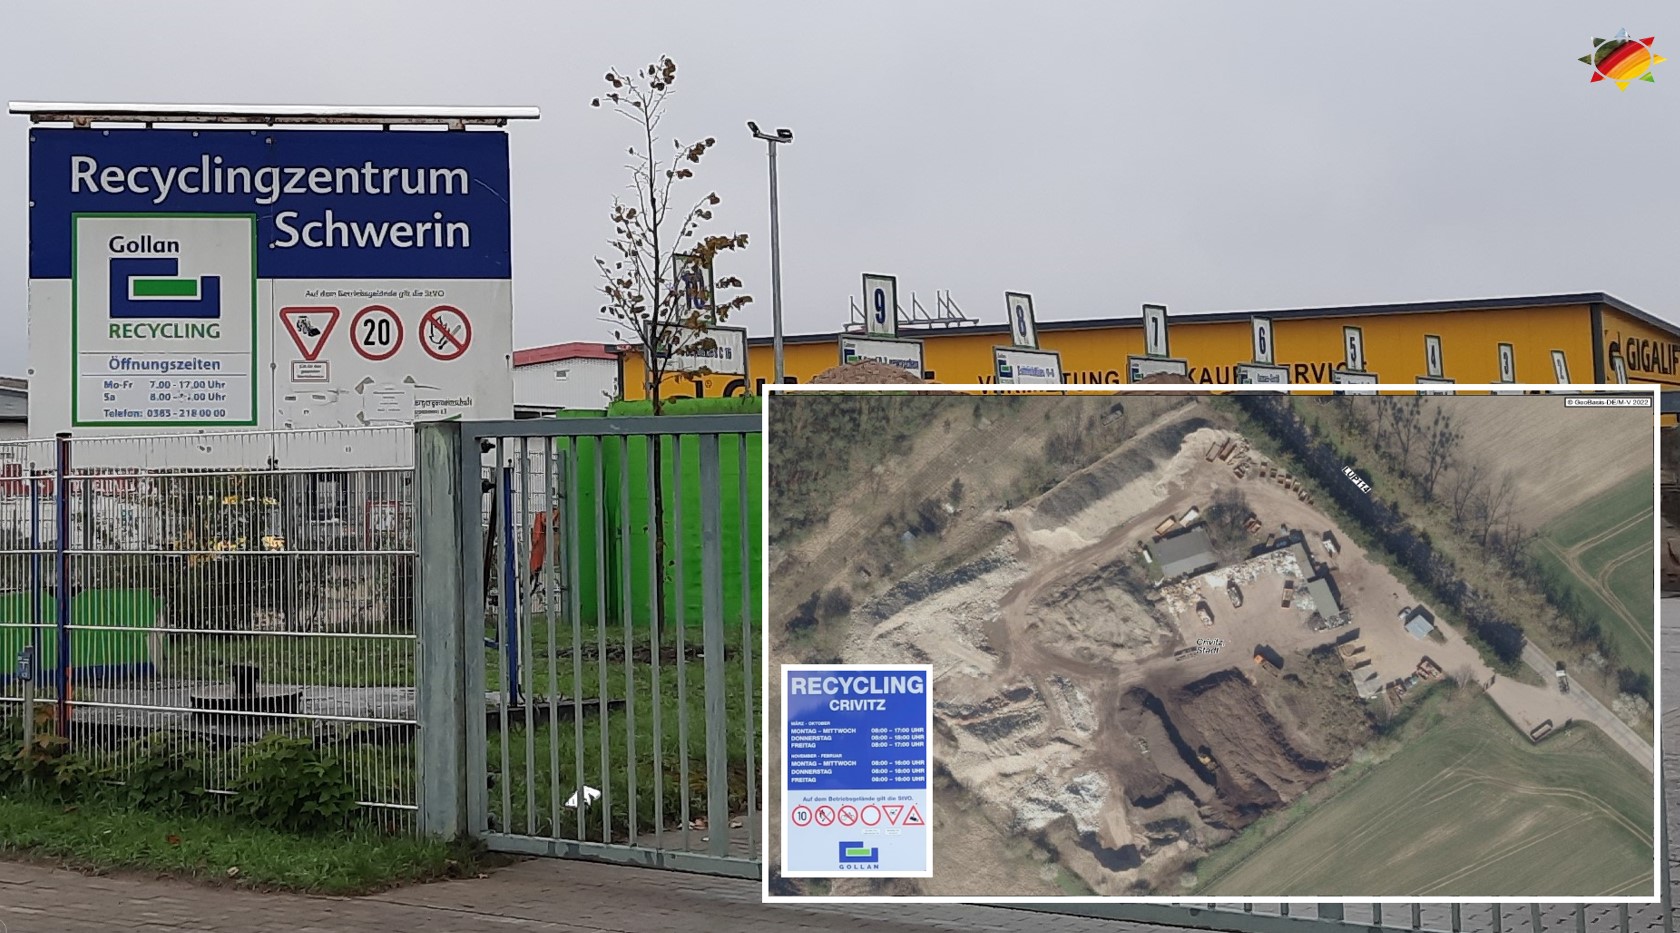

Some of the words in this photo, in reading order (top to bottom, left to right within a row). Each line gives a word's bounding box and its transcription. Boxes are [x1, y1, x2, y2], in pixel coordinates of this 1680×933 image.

[70, 154, 470, 205] Recyclingzentrum
[274, 210, 470, 249] Schwerin
[109, 234, 180, 255] Gollan
[873, 288, 886, 325] 9
[109, 323, 220, 339] RECYCLING
[363, 318, 390, 346] 20
[1015, 304, 1028, 338] 8
[1151, 316, 1159, 348] 7
[1258, 326, 1267, 355] 6
[1349, 336, 1357, 362] 5
[109, 355, 221, 374] Öffnungszeiten
[103, 381, 133, 390] Mo-Fr
[150, 381, 171, 390] 7.00
[180, 381, 206, 390] 17.00
[208, 380, 227, 389] Uhr
[103, 393, 116, 401] Sa
[150, 393, 171, 401] 8.00
[208, 392, 227, 401] Uhr
[791, 676, 924, 695] RECYCLING
[829, 699, 886, 711] CRIVITZ
[797, 811, 807, 821] 10
